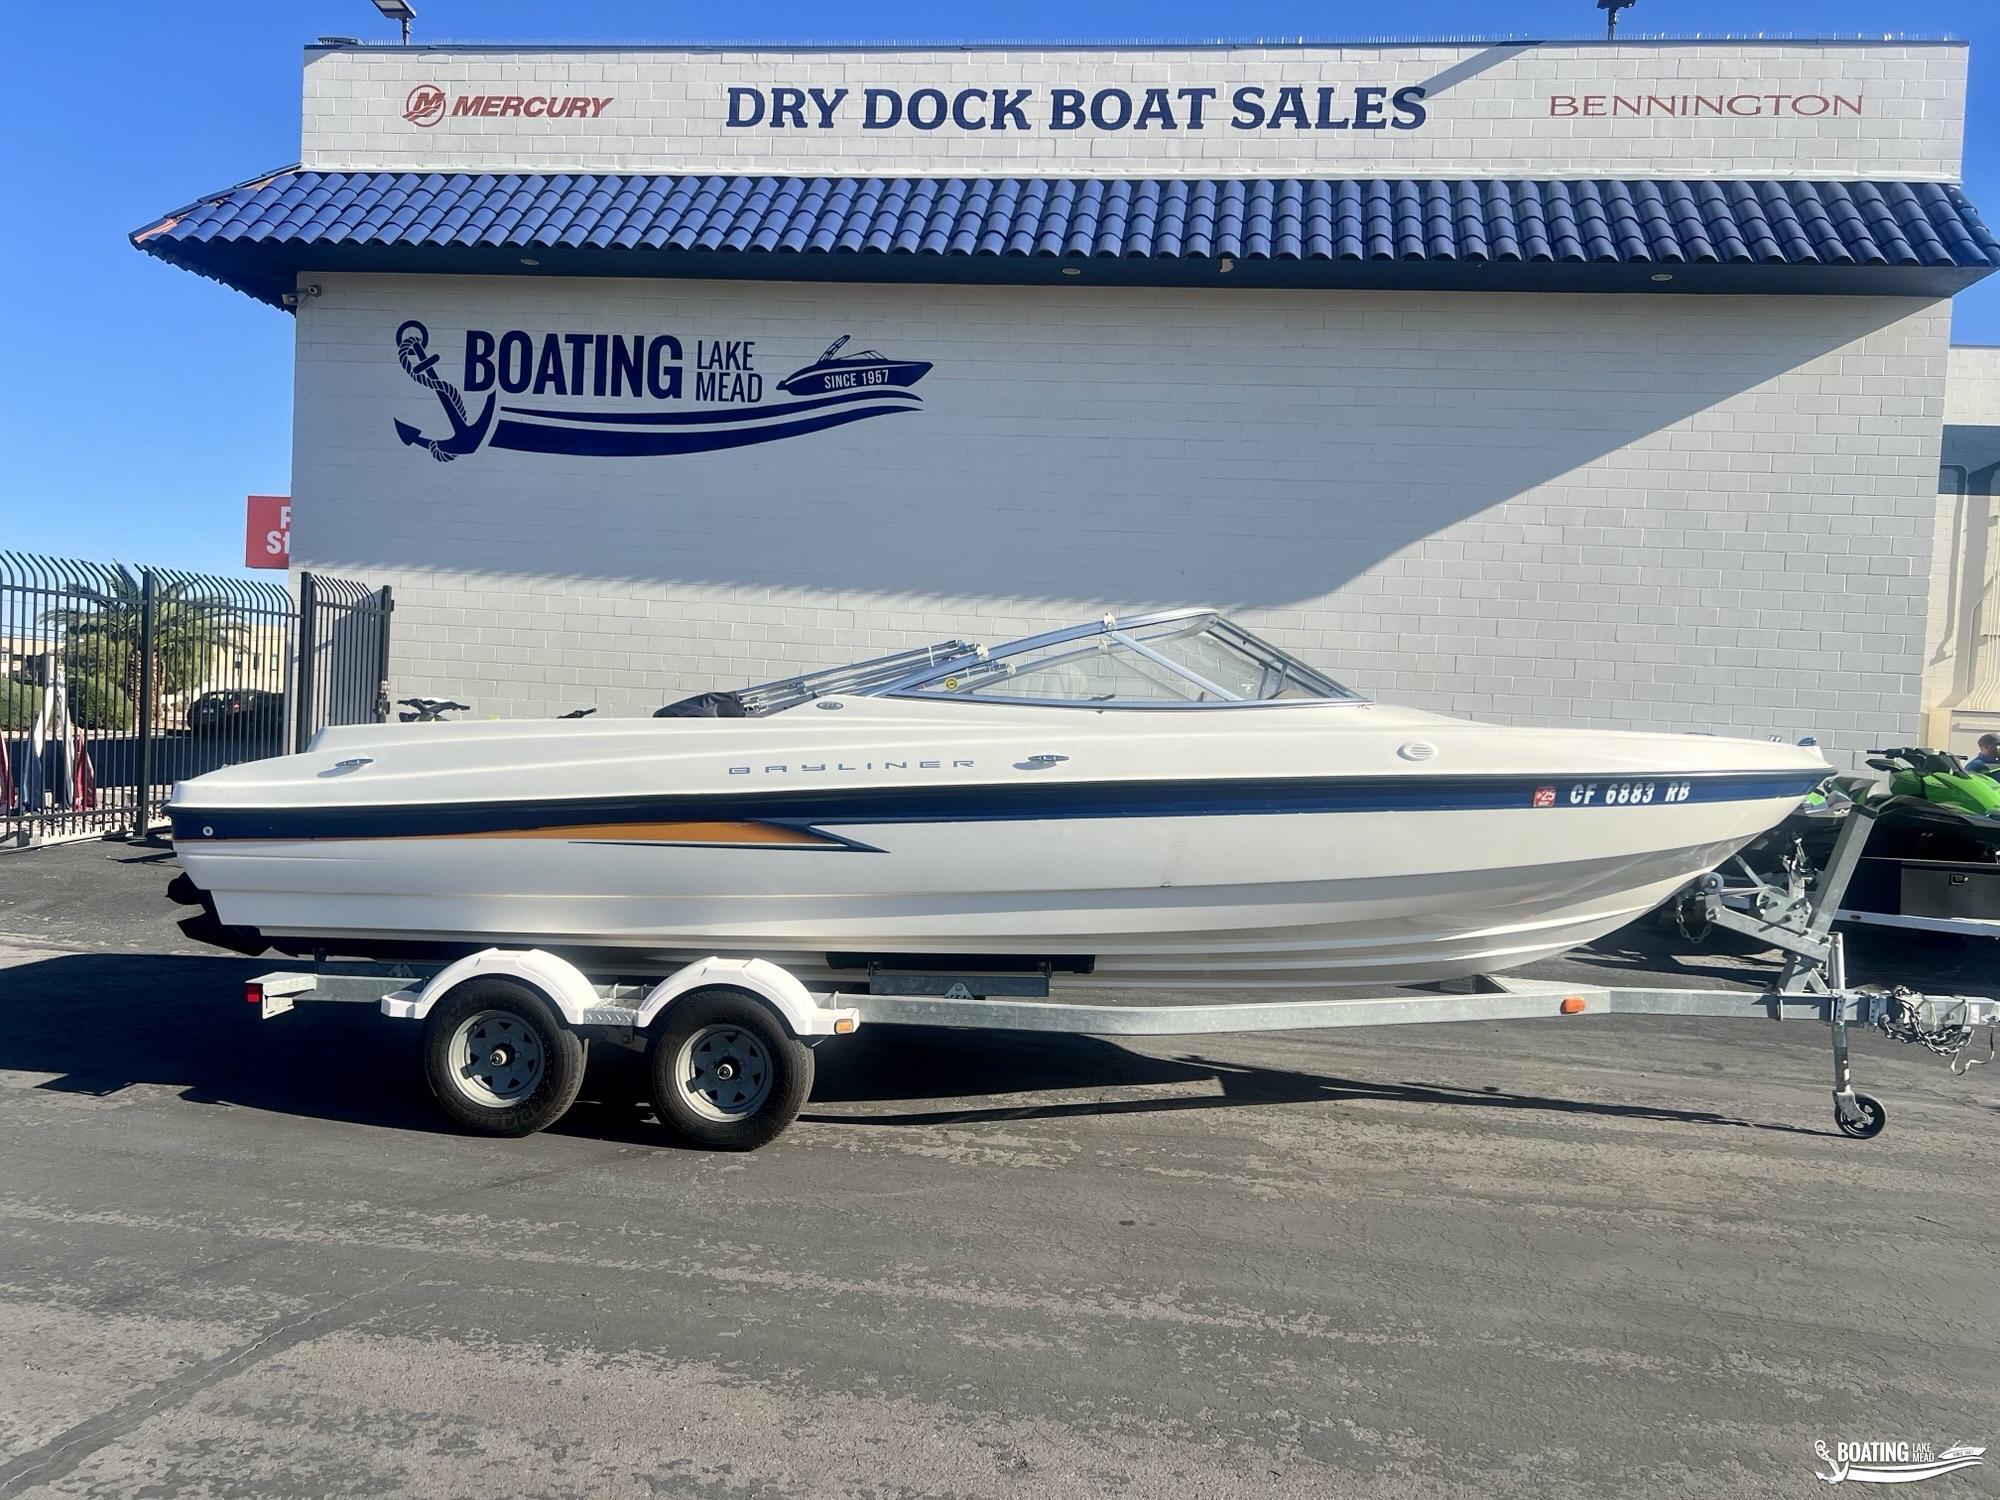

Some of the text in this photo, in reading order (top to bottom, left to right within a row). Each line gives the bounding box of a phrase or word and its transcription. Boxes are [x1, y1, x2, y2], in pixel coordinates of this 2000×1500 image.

[452, 96, 614, 118] MERCURY
[726, 86, 1427, 130] DRY DOCK BOAT SALES
[1550, 94, 1862, 117] BENNINGTON
[464, 330, 683, 399] BOATING
[697, 340, 755, 371] LAKE
[695, 372, 763, 403] MEAD
[824, 369, 889, 389] SINCE 1957
[728, 760, 975, 774] BAYLINER
[1570, 783, 1597, 804] CF
[1605, 782, 1655, 804] 6883
